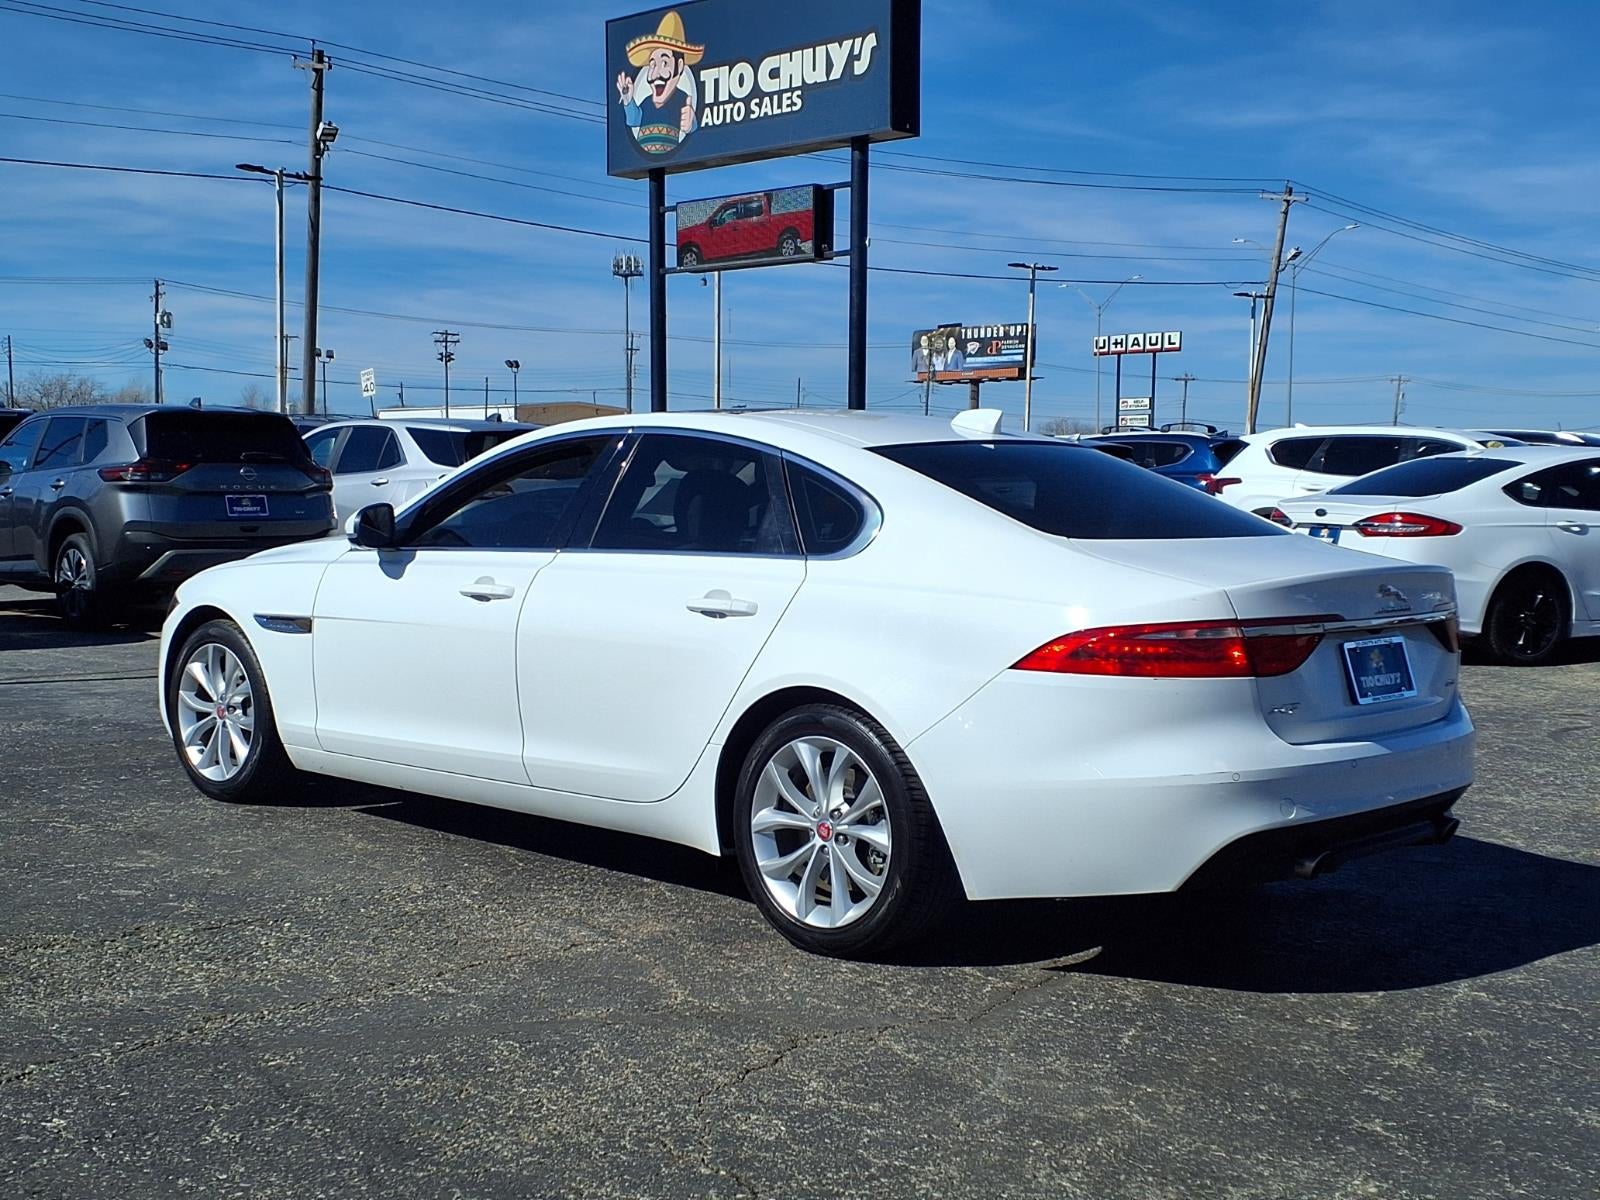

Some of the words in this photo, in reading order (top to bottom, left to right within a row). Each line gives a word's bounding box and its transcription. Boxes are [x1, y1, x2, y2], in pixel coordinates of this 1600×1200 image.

[700, 62, 755, 104] TIO
[757, 32, 878, 93] CHUY'S
[700, 101, 746, 128] AUTO
[750, 89, 803, 119] SALES
[961, 325, 1005, 339] THUNDER
[1009, 324, 1027, 337] UP!
[363, 382, 375, 392] 40
